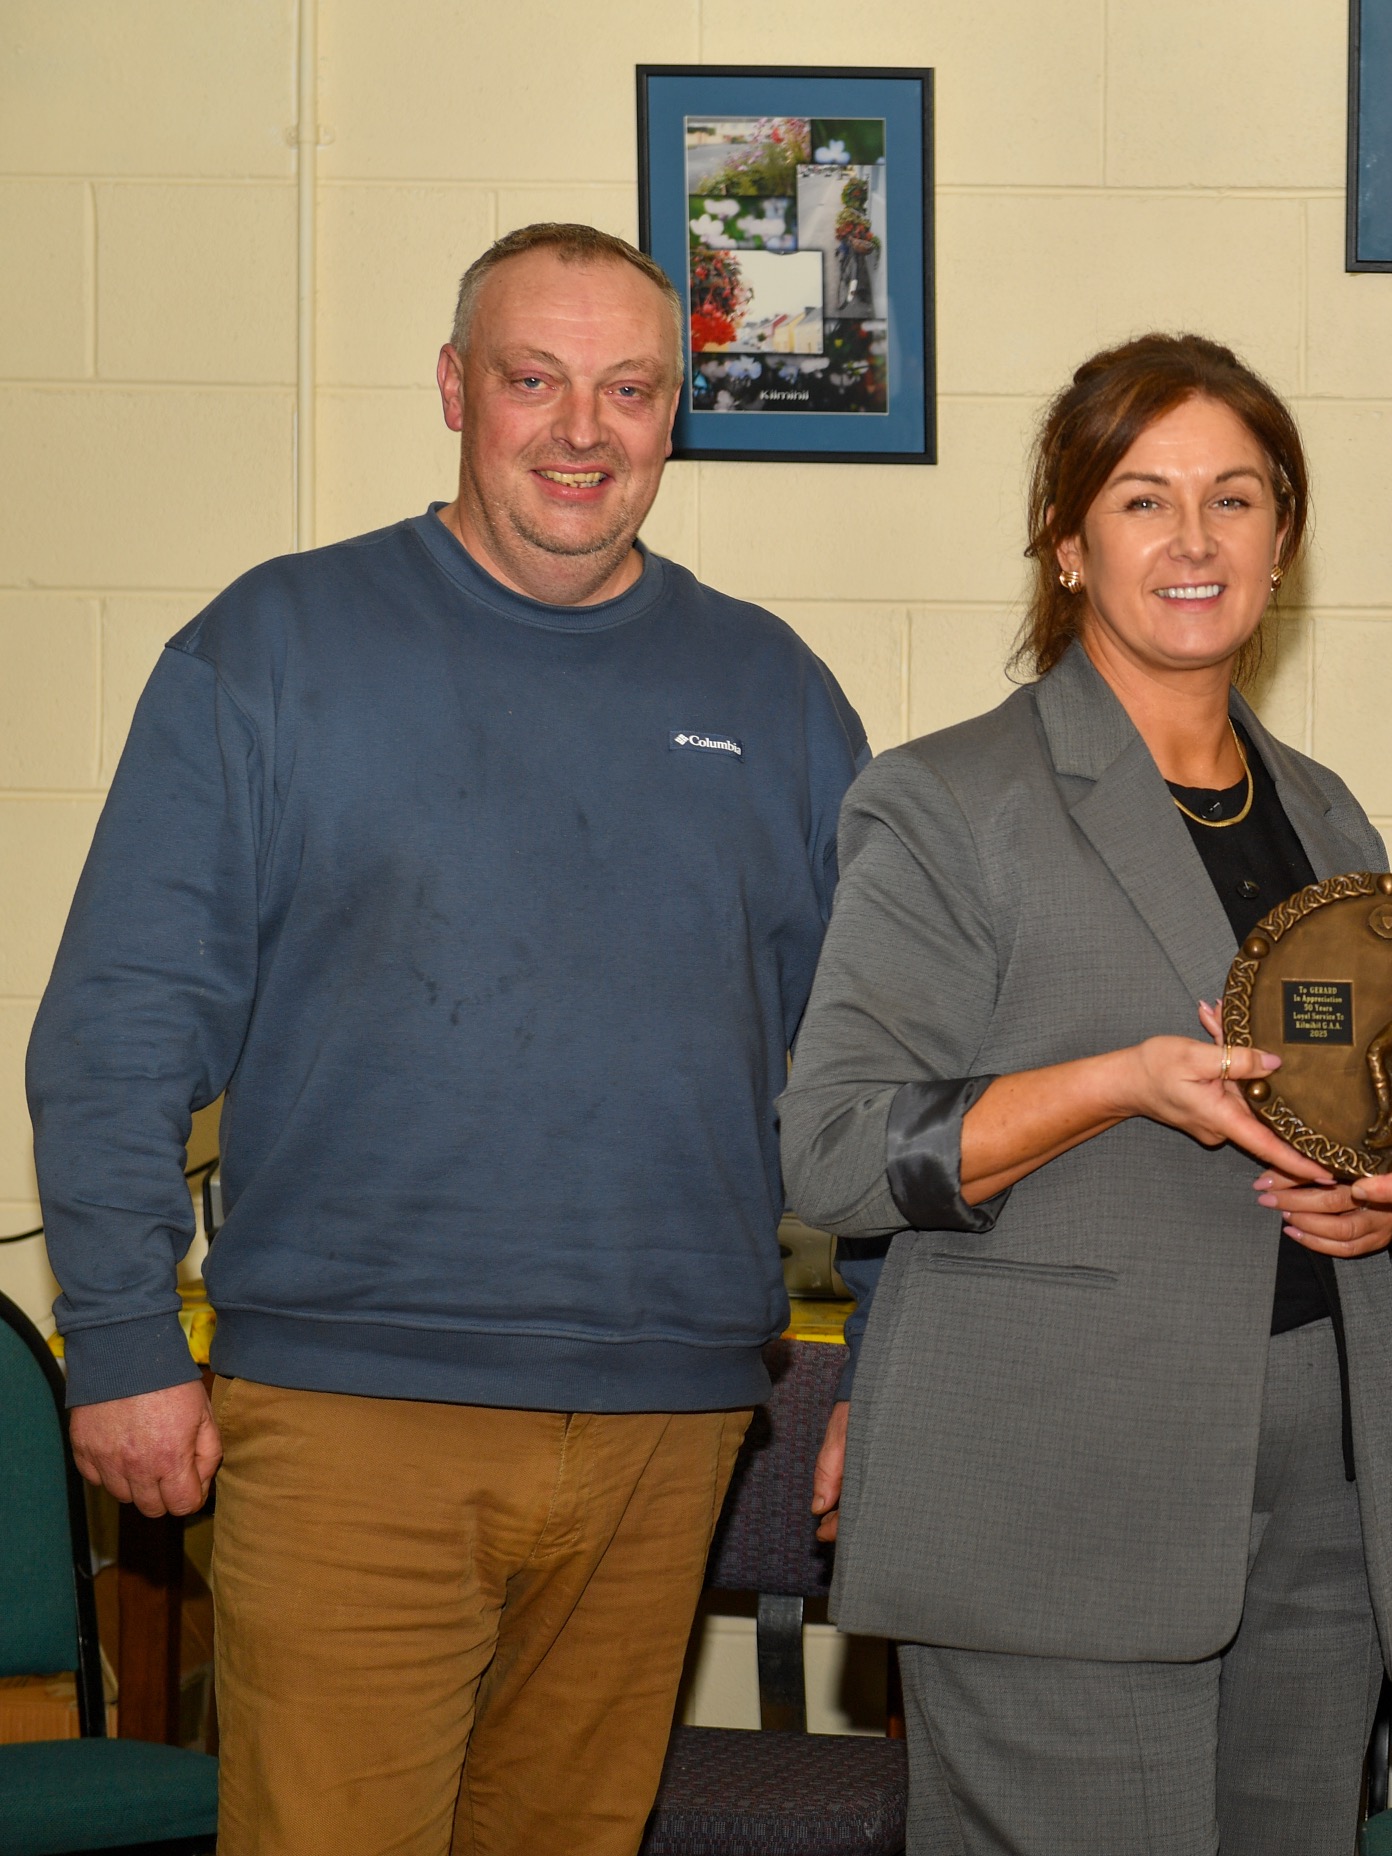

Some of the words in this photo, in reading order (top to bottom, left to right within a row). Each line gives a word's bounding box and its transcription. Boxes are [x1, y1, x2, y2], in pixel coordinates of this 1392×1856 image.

[688, 734, 742, 756] Columbia
[1298, 986, 1307, 994] To
[1309, 986, 1337, 994] GERARD
[1293, 994, 1301, 1002] In
[1302, 994, 1343, 1003] Appreciation
[1314, 1003, 1333, 1012] Years
[1293, 1011, 1310, 1021] Loyal
[1311, 1012, 1336, 1021] Service
[1310, 1030, 1327, 1038] 2025
